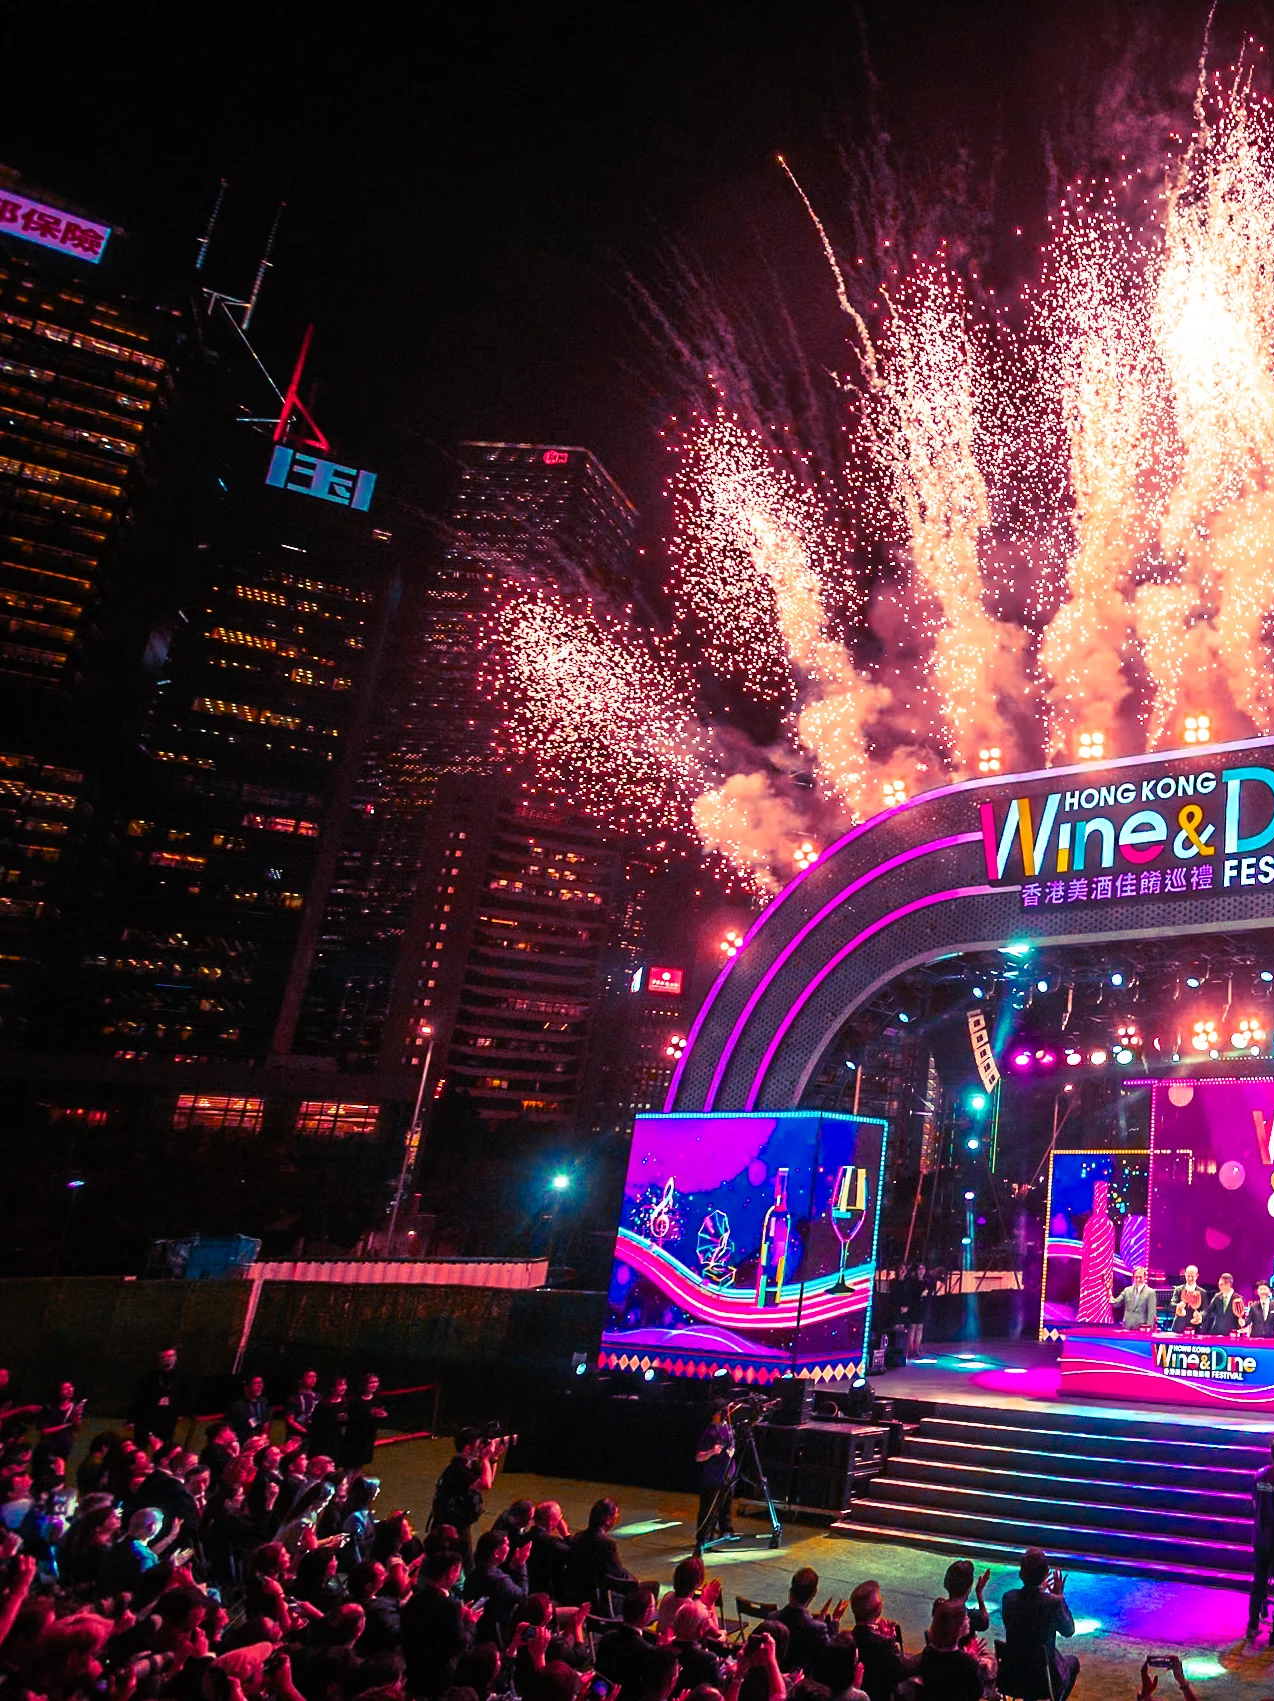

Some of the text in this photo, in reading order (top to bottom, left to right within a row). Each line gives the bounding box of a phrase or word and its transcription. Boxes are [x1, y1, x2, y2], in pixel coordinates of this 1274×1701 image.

[1064, 771, 1217, 811] HONG KONG
[981, 792, 1168, 880] Wine
[1021, 864, 1214, 907] 香港美酒佳餚巡禮
[1211, 1370, 1244, 1380] FESTIVAL
